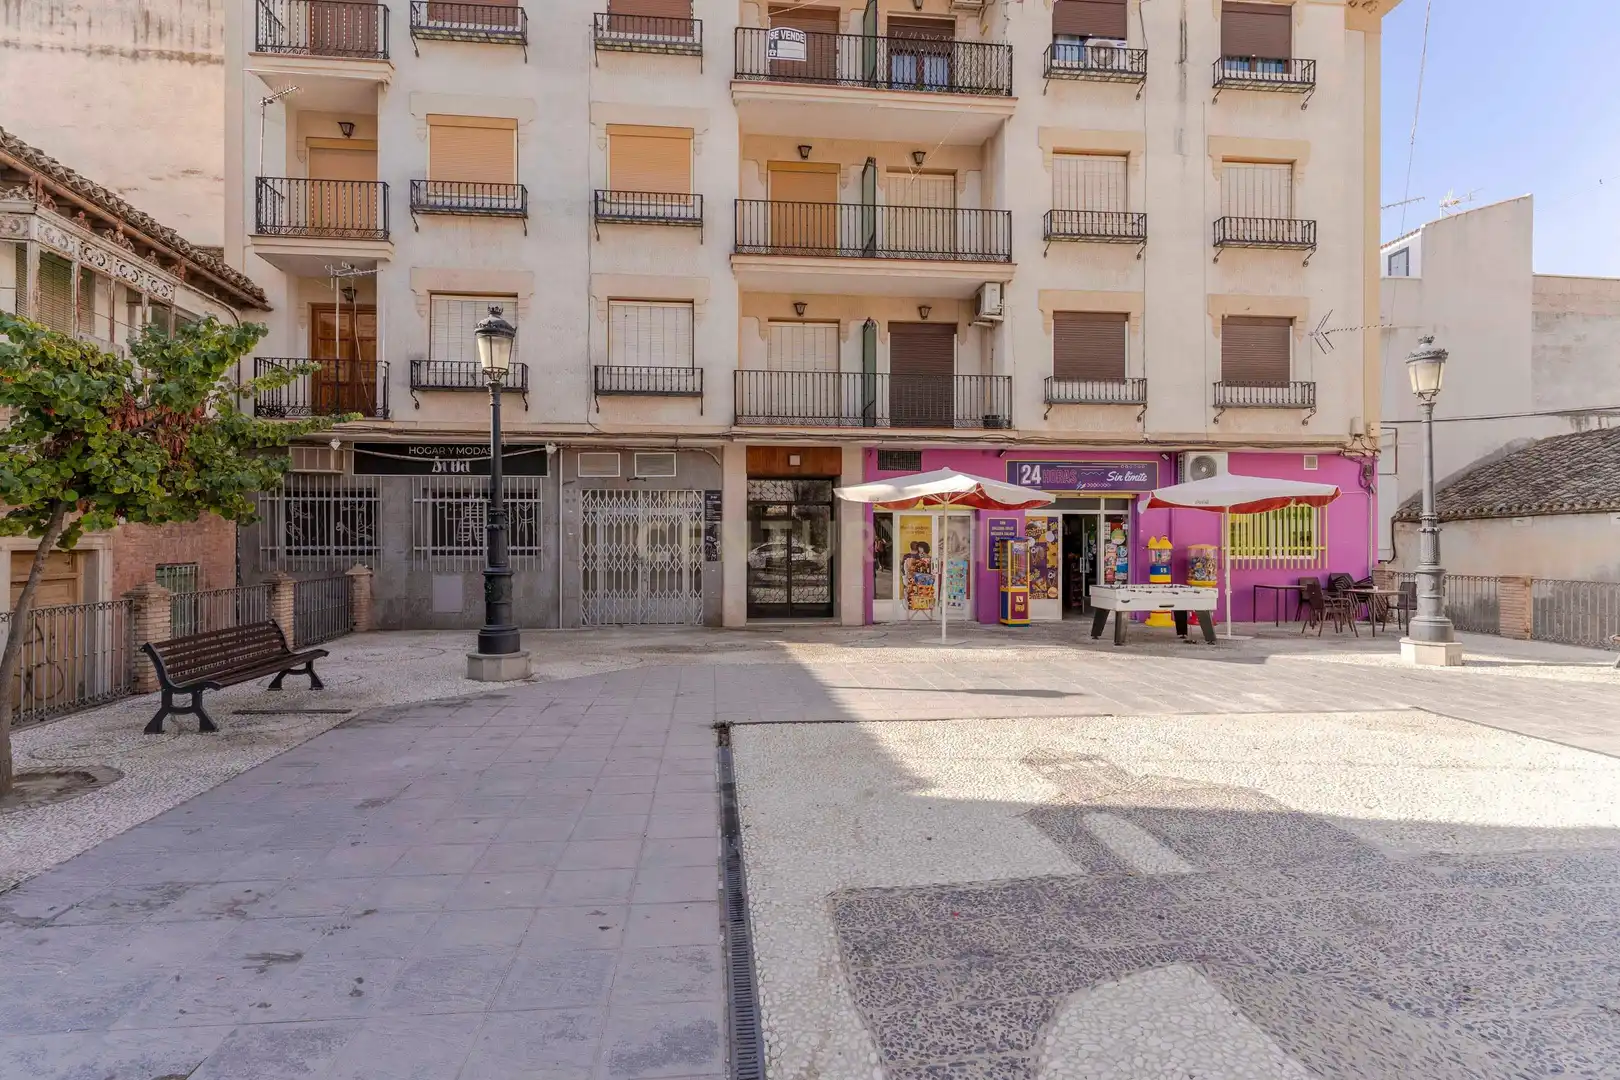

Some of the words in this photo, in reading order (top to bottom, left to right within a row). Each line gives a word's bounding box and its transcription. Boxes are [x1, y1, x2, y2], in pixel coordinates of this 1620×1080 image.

[770, 30, 780, 40] SE
[780, 29, 804, 43] VENDE
[408, 446, 446, 455] HOGAR
[448, 446, 455, 455] Y
[456, 446, 492, 455] MODAS
[1021, 465, 1042, 484] 24
[1042, 469, 1078, 484] HORAS
[1106, 470, 1124, 482] Sin
